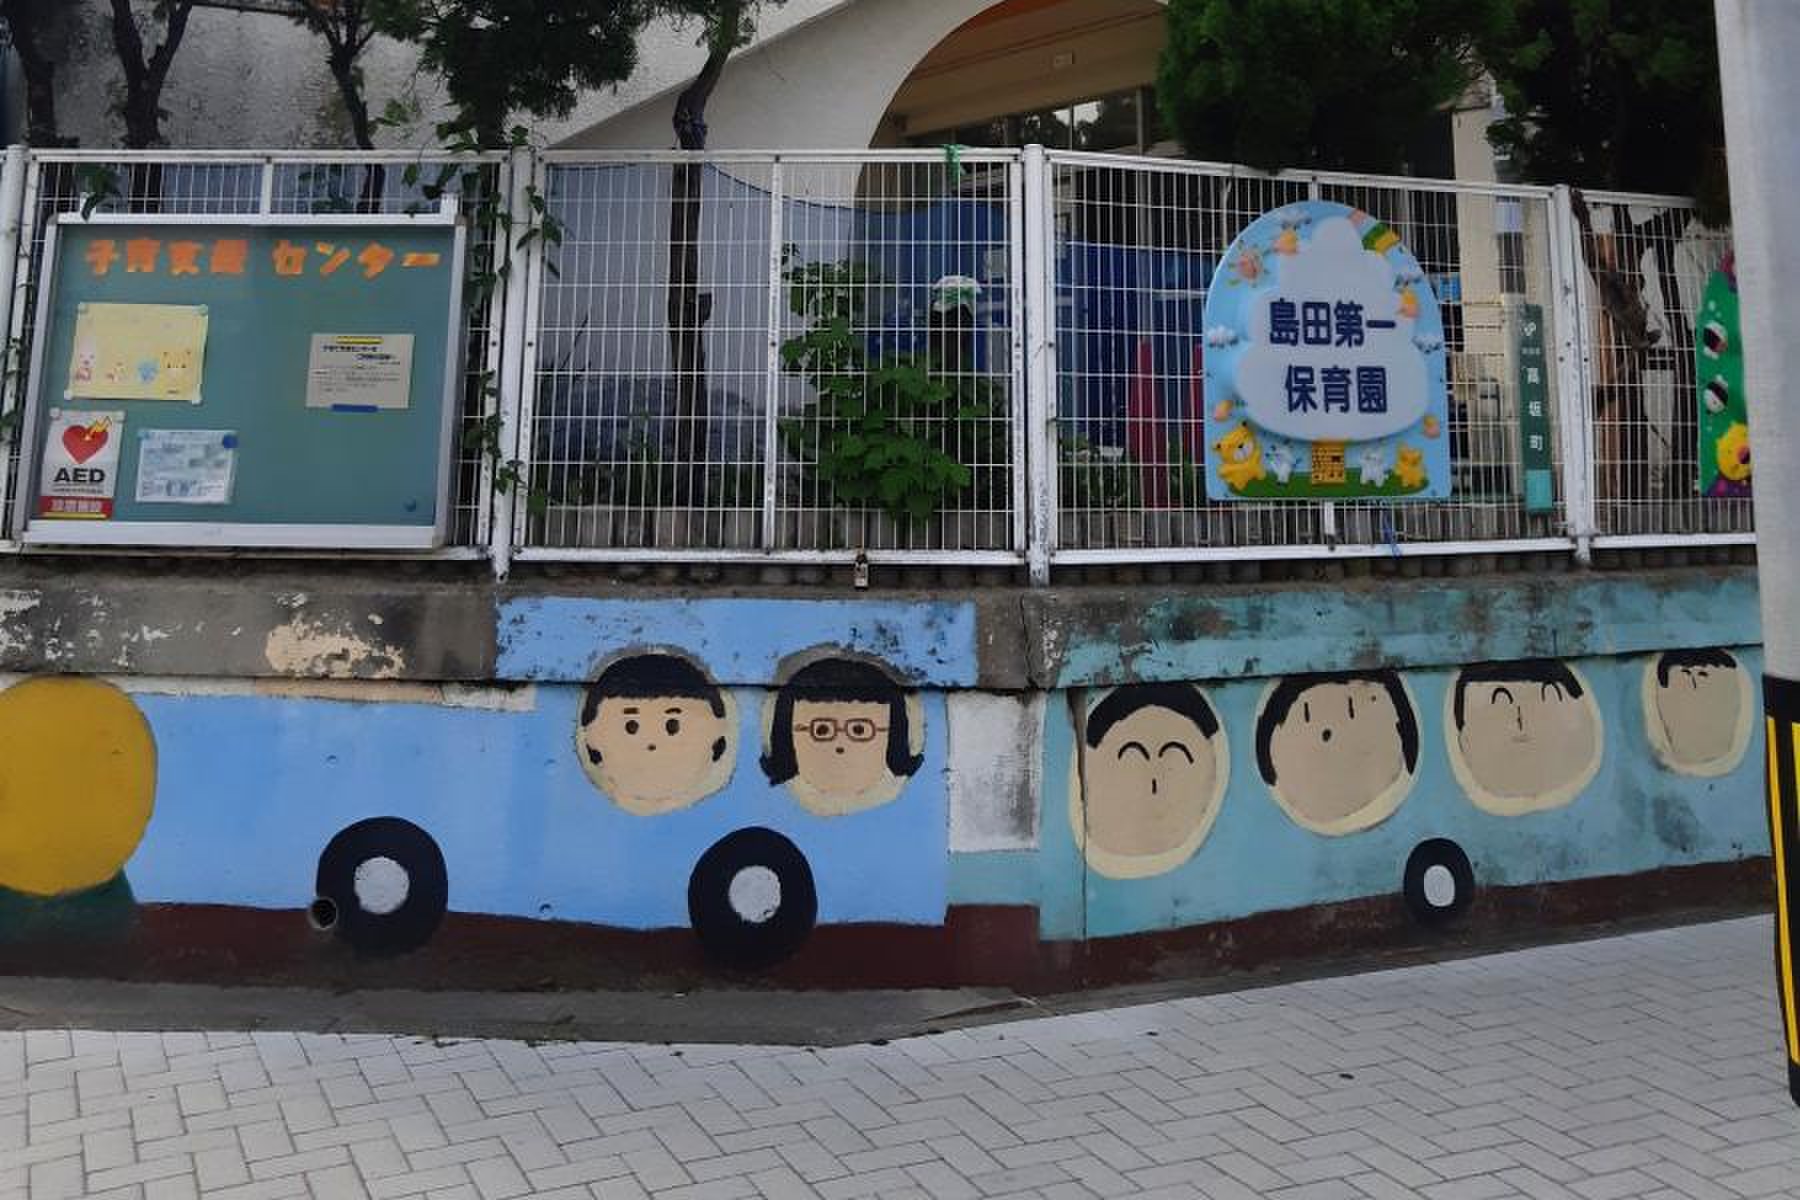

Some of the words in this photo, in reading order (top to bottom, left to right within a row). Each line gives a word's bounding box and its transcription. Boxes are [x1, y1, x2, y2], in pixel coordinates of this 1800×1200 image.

[273, 240, 440, 278] センター
[1270, 298, 1396, 347] 島田第一
[1285, 364, 1387, 413] 保育園
[53, 467, 105, 482] AED
